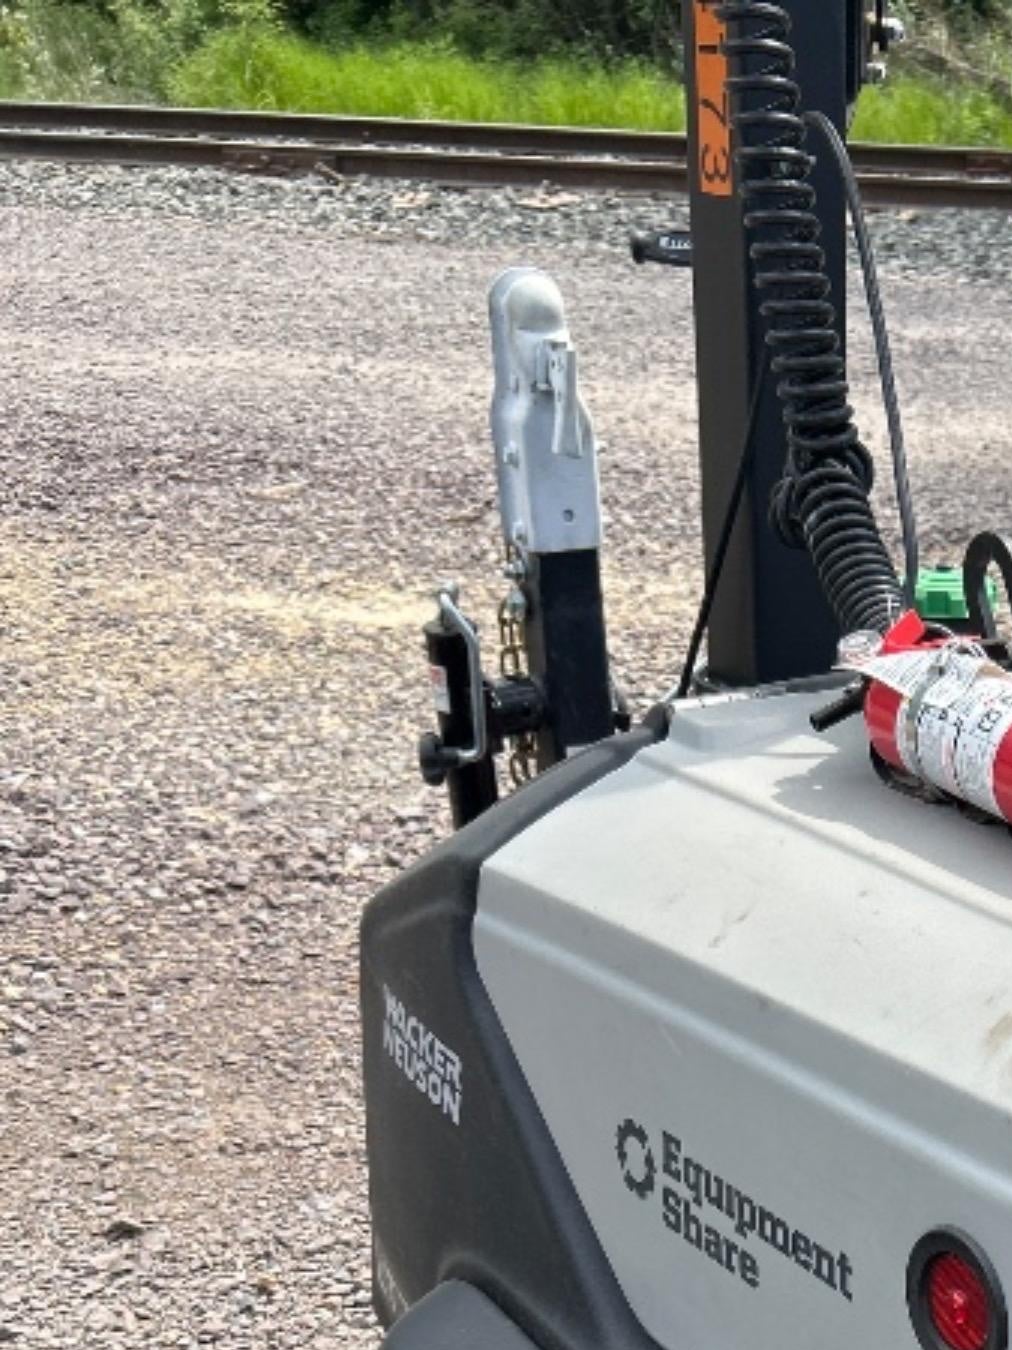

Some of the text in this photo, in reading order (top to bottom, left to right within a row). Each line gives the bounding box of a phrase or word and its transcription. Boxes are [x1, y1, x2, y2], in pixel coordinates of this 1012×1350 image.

[697, 0, 729, 183] 173
[383, 983, 462, 1093] WACKER
[383, 1019, 462, 1126] NEUSON
[661, 1130, 854, 1302] Equipment
[661, 1187, 760, 1288] Share
